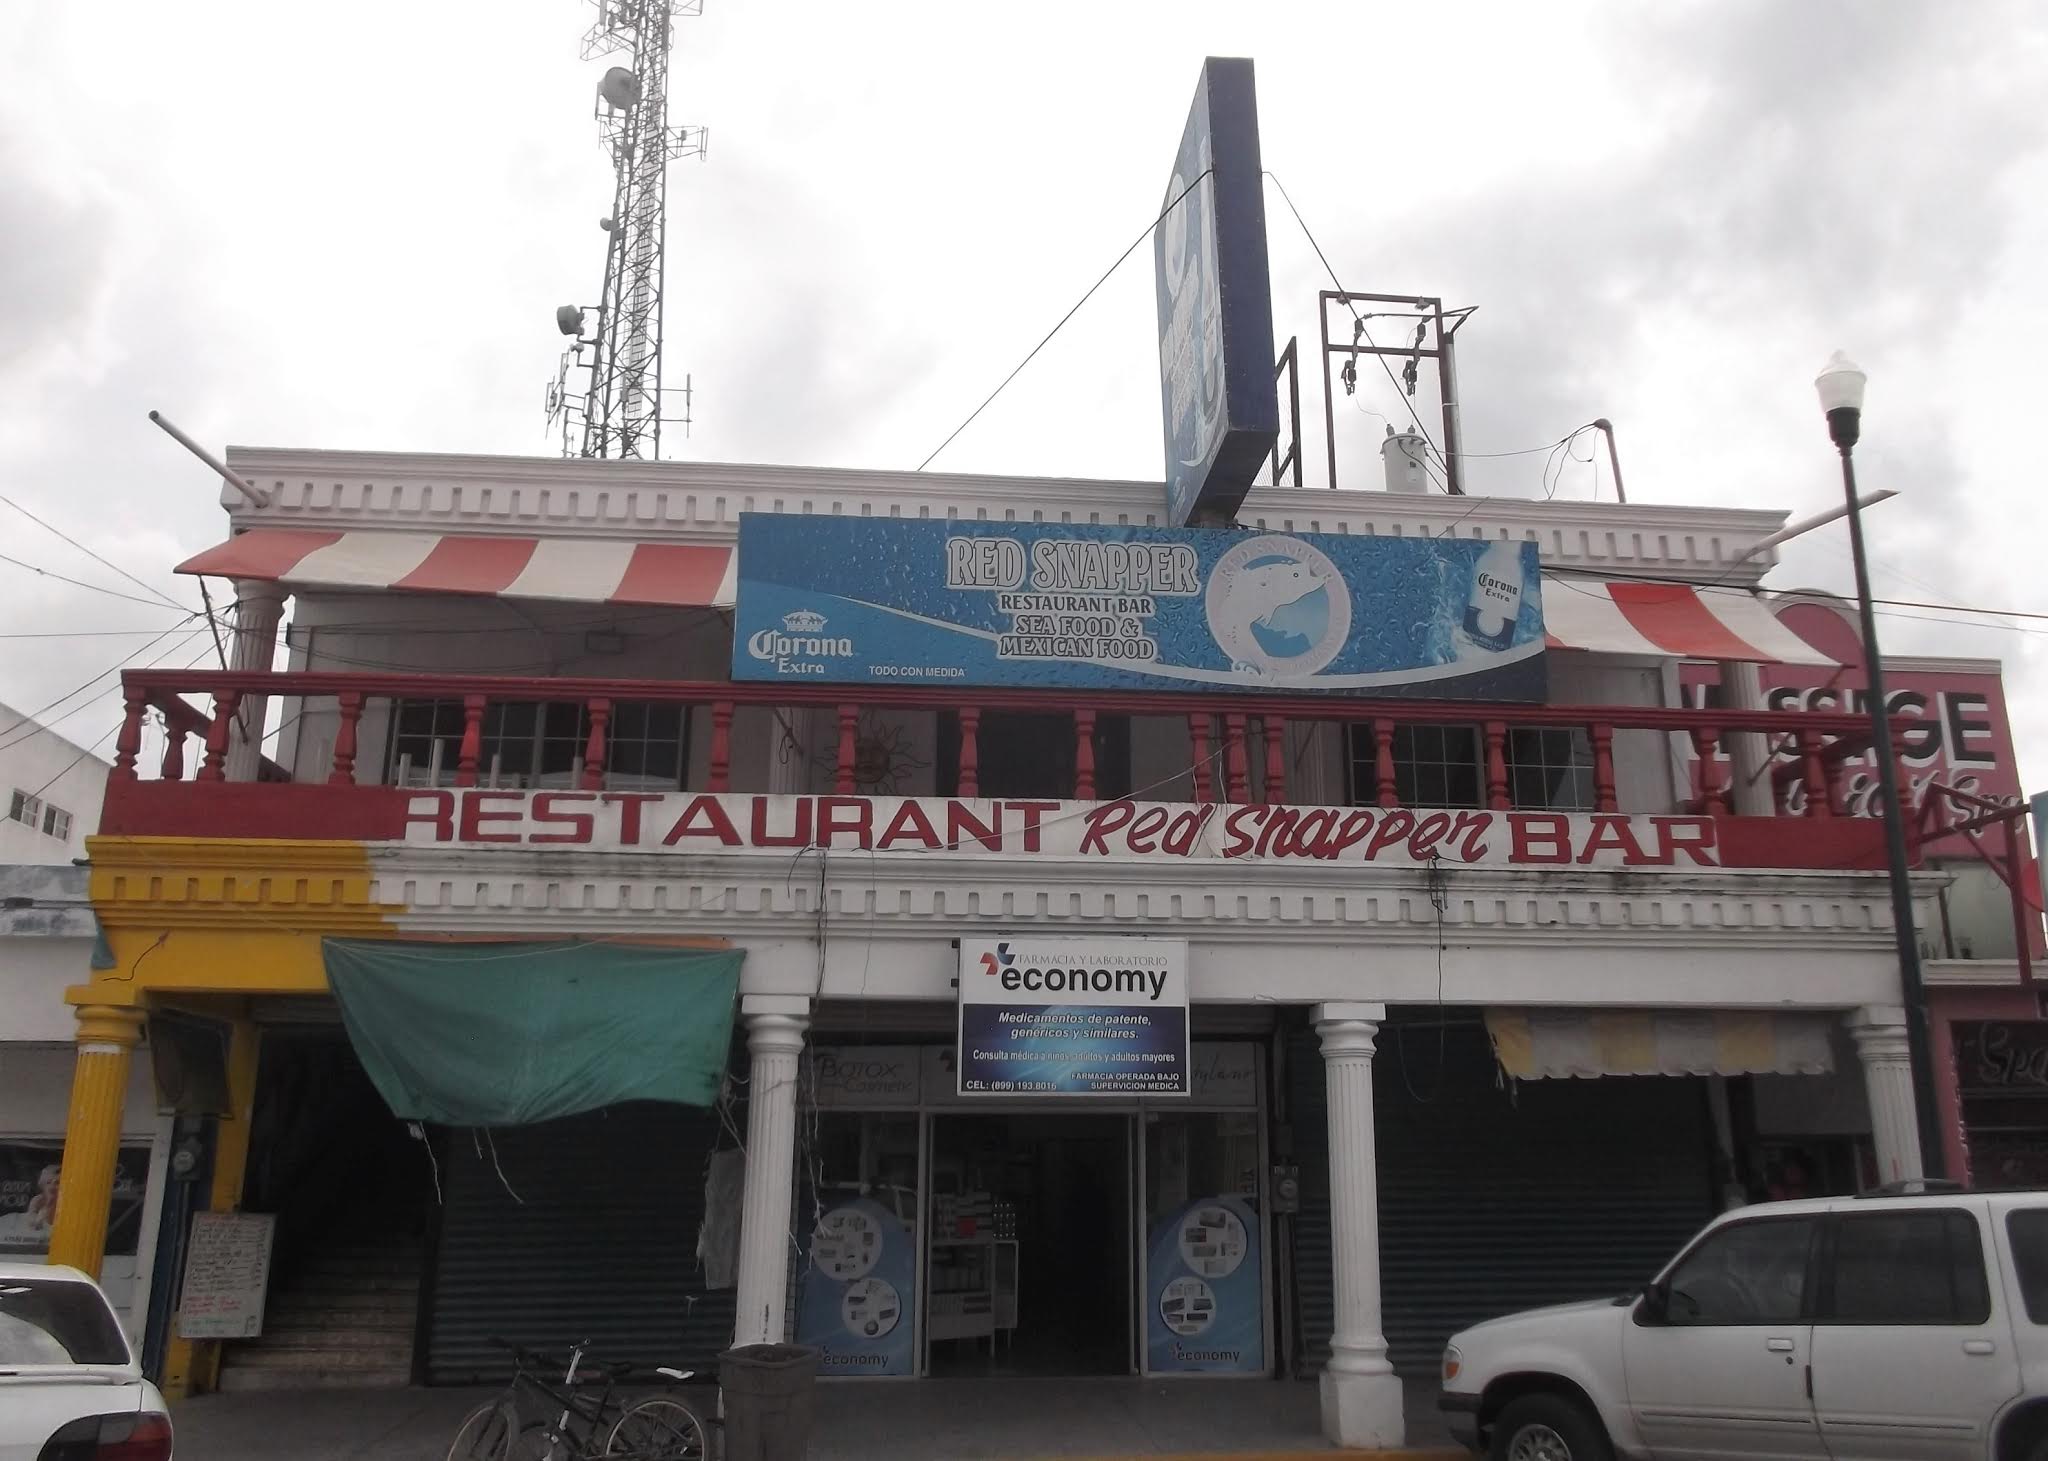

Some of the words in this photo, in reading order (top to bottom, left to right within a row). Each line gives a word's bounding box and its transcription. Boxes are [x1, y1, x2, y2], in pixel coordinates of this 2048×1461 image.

[949, 539, 1024, 588] RED
[1033, 541, 1198, 592] SNAPPER
[1478, 572, 1517, 596] Corona
[1001, 594, 1112, 612] RESTAURANT
[1118, 597, 1152, 613] BAR
[1485, 589, 1511, 603] Extra
[1016, 615, 1056, 635] SEA
[1059, 617, 1116, 636] FOOD
[1120, 618, 1139, 637] &
[748, 629, 854, 663] Corona
[1000, 636, 1094, 657] MEXICAN
[1097, 638, 1155, 659] FOOD
[778, 657, 825, 674] Extra
[869, 665, 899, 676] TODO
[900, 666, 923, 677] CON
[925, 667, 966, 678] MEDIDA
[401, 790, 1061, 852] RESTAURANT
[1078, 800, 1216, 856] Red
[1221, 804, 1493, 863] Snapper
[1506, 813, 1721, 867] BAR
[1019, 954, 1076, 966] FARMACIA
[1079, 955, 1087, 966] Y
[1089, 955, 1168, 967] LABORATORIO
[1001, 967, 1168, 1001] economy
[998, 1012, 1084, 1024] Medicamentos
[1087, 1014, 1102, 1025] de
[1104, 1015, 1152, 1026] patente,
[1010, 1027, 1069, 1040] genéricos
[1072, 1030, 1079, 1040] y
[1083, 1028, 1140, 1040] similares.
[973, 1049, 1008, 1061] Consulta
[1010, 1049, 1039, 1061] médica
[1104, 1052, 1110, 1064] y
[1111, 1051, 1140, 1062] adultos
[1142, 1053, 1176, 1065] mayores
[1071, 1072, 1114, 1081] FARMACIA
[1115, 1072, 1157, 1081] OPERADA
[1157, 1073, 1180, 1081] BAJO
[966, 1080, 989, 1090] CEL:
[991, 1080, 1015, 1092] (899)
[1090, 1081, 1146, 1090] SUPERVICION
[1147, 1082, 1180, 1091] MEDICA
[823, 1354, 889, 1368] economy
[1177, 1351, 1240, 1363] economy
